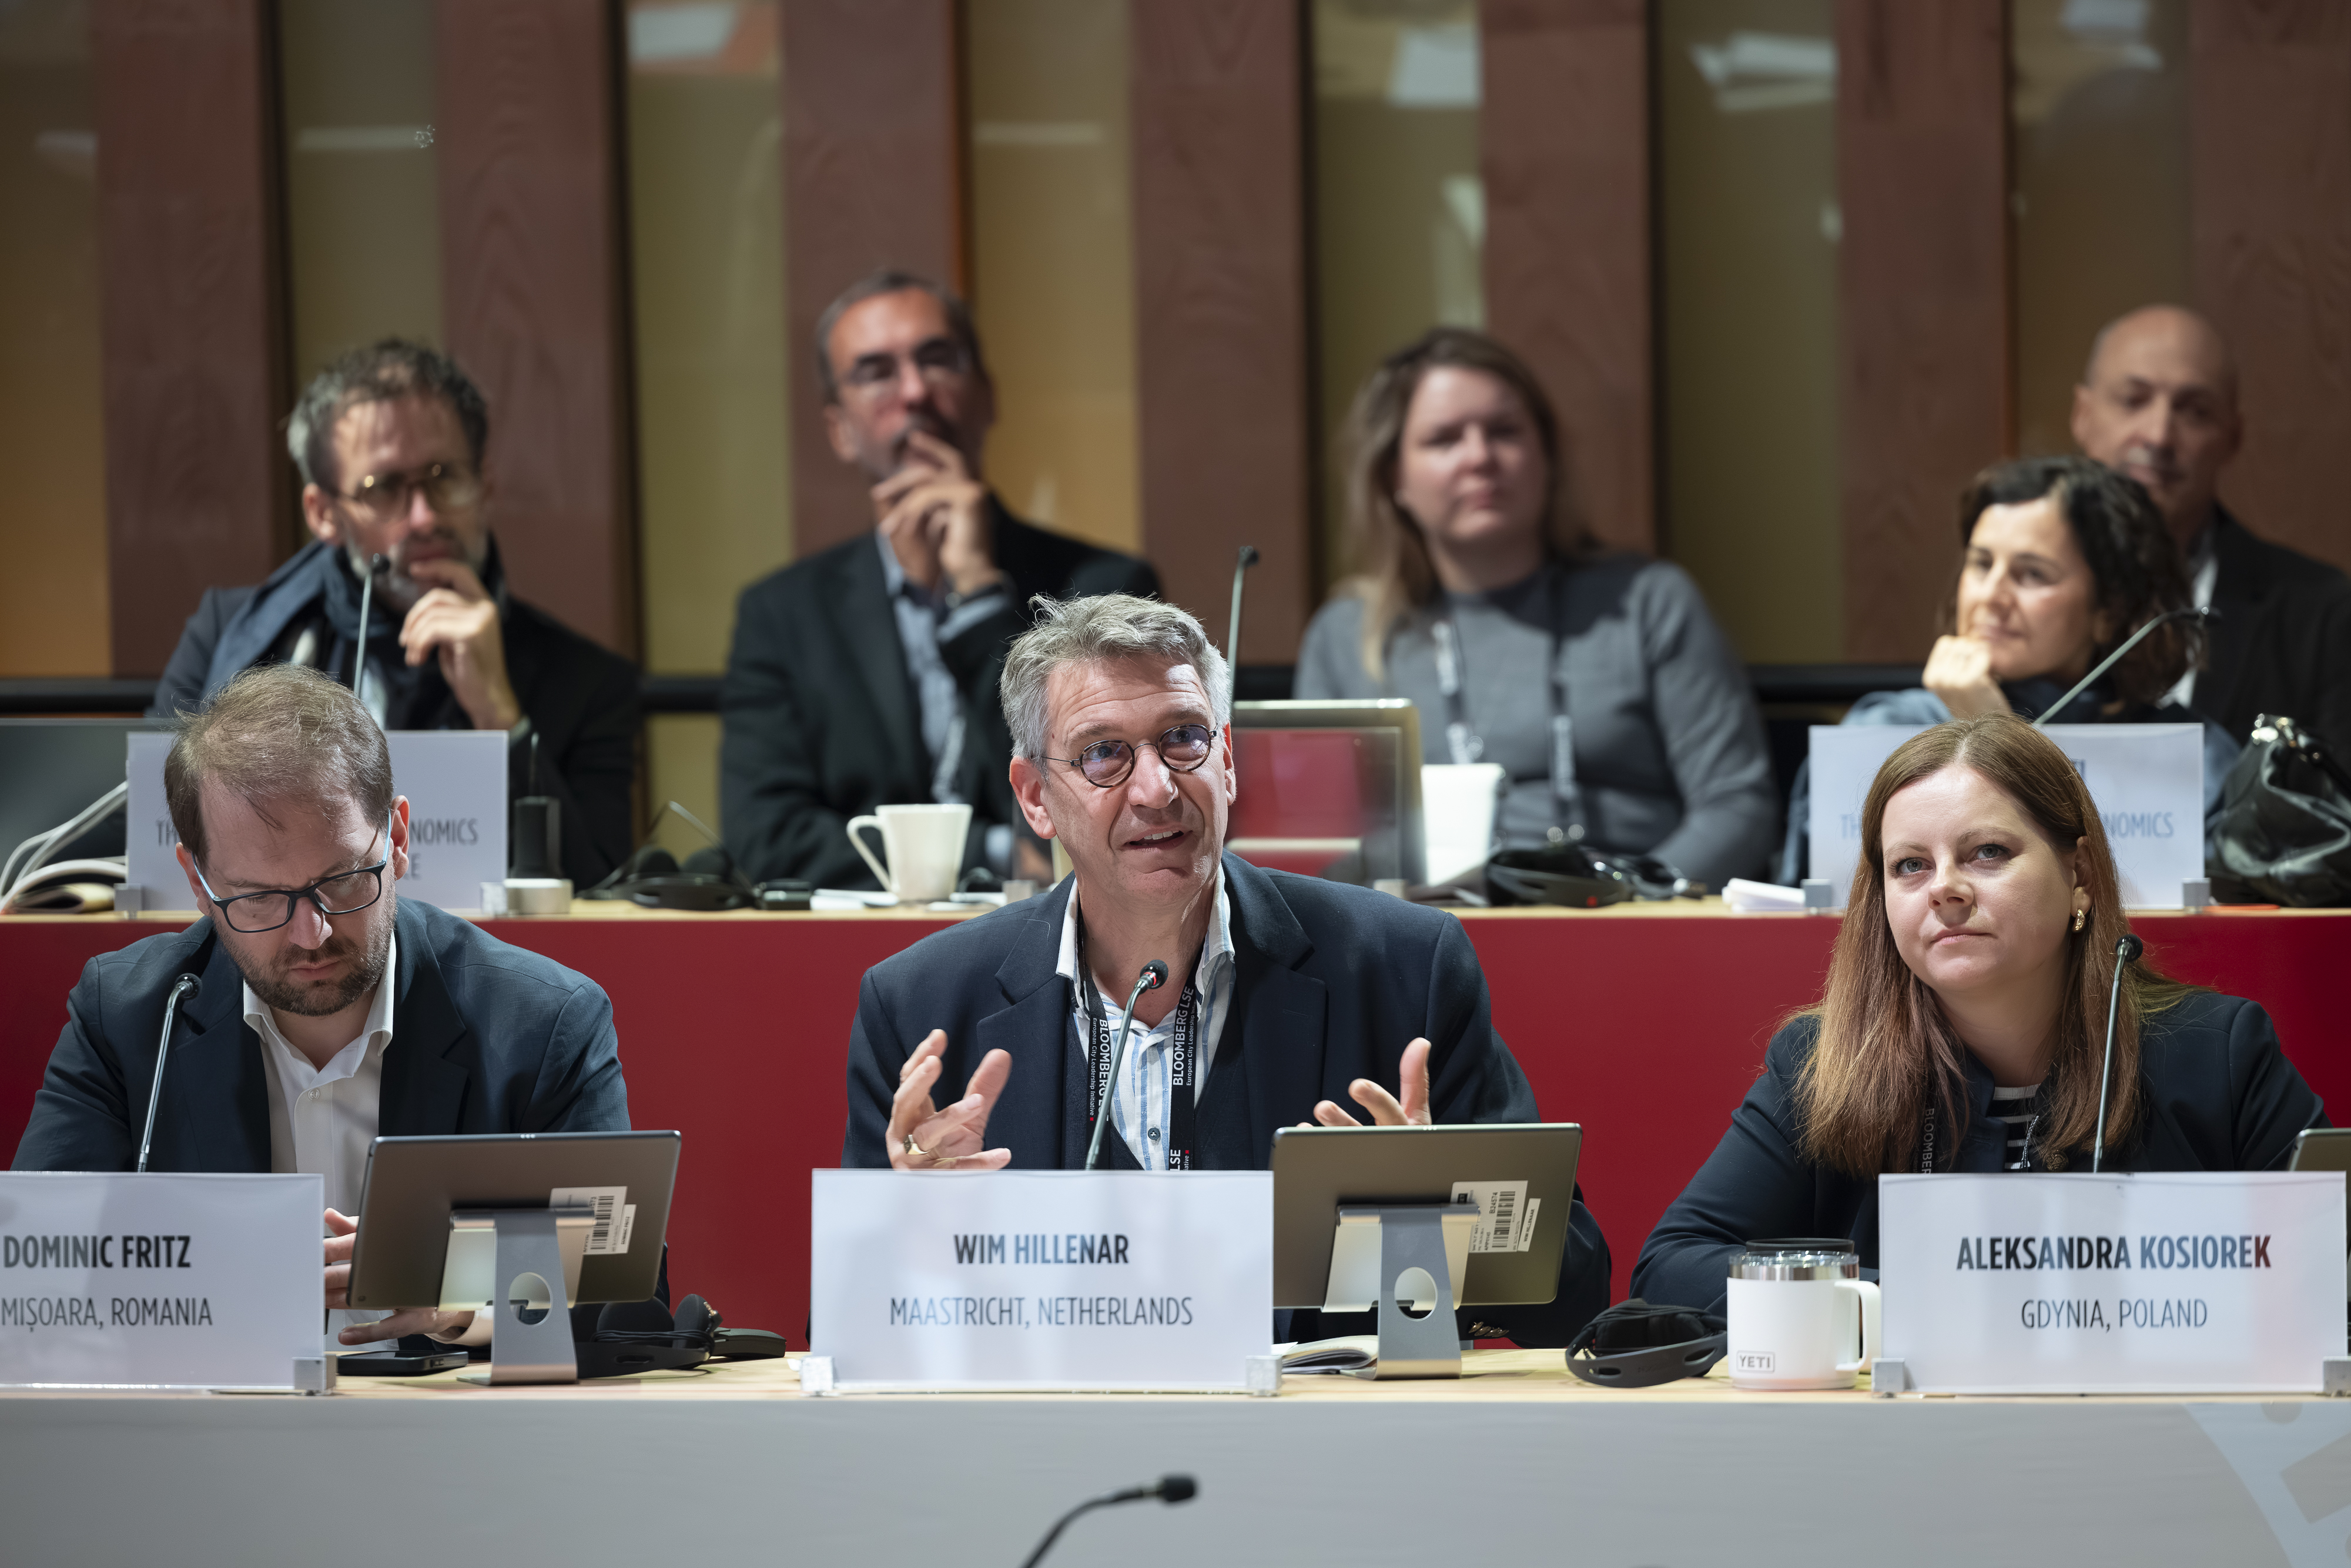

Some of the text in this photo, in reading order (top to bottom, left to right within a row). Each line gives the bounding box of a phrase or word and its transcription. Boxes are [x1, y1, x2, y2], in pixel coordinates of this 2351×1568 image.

[156, 817, 478, 845] TH NOMICS
[1840, 812, 2174, 839] TH NOMICS
[1173, 986, 1194, 1085] BLOOMBERG LSE
[1921, 1108, 1935, 1174] BLOOMBER
[1170, 1149, 1181, 1171] LSE
[4, 1235, 192, 1268] DOMINIC FRITZ
[953, 1234, 1130, 1264] WIM HILLENAR
[1957, 1235, 2272, 1271] ALEKSANDRA KOSIOREK
[1, 1297, 213, 1332] MIȘOARA, ROMANIA
[890, 1296, 1194, 1329] MAASTRICHT, NETHERLANDS
[2021, 1299, 2208, 1332] GDYNIA, POLAND
[1739, 1355, 1771, 1368] YETI
